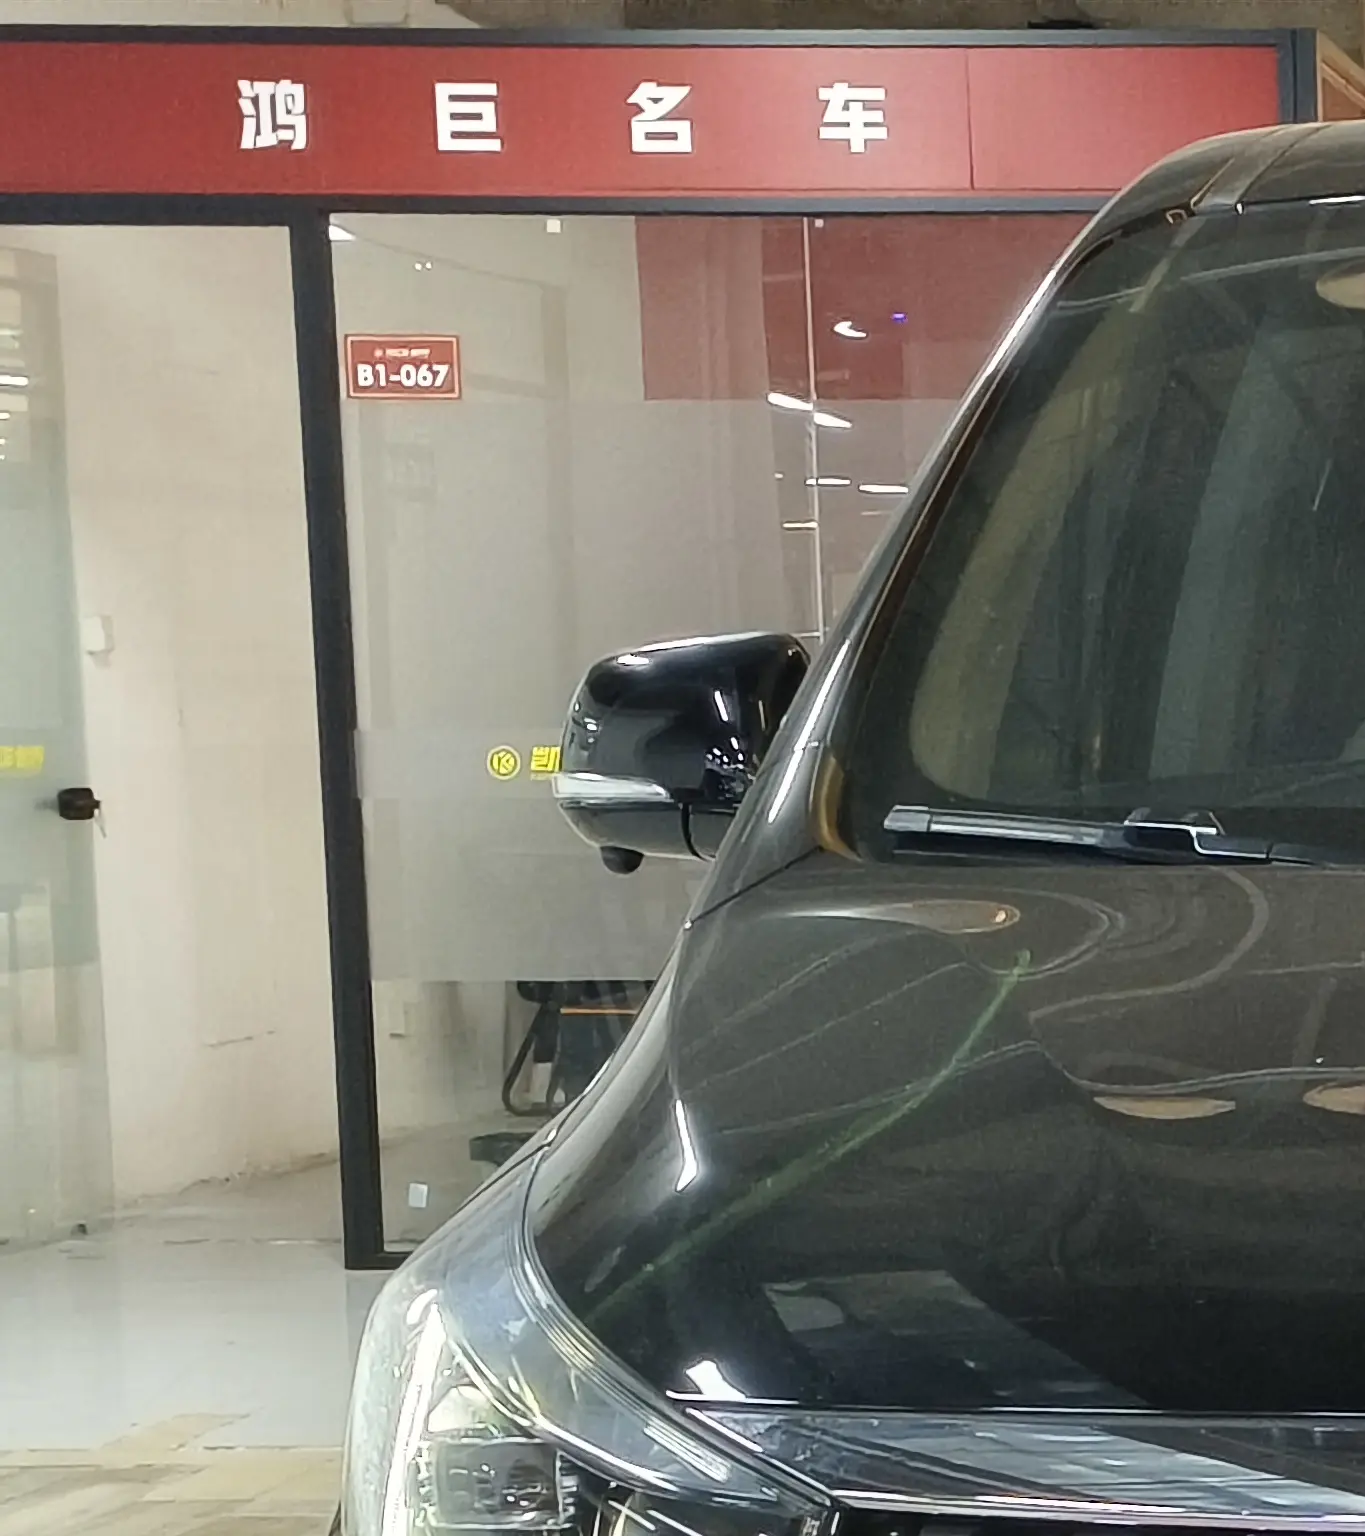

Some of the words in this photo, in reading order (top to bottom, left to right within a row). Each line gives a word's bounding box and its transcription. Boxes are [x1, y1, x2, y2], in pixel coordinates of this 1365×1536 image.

[236, 78, 894, 157] 鸿巨名车
[356, 363, 450, 388] B1-067
